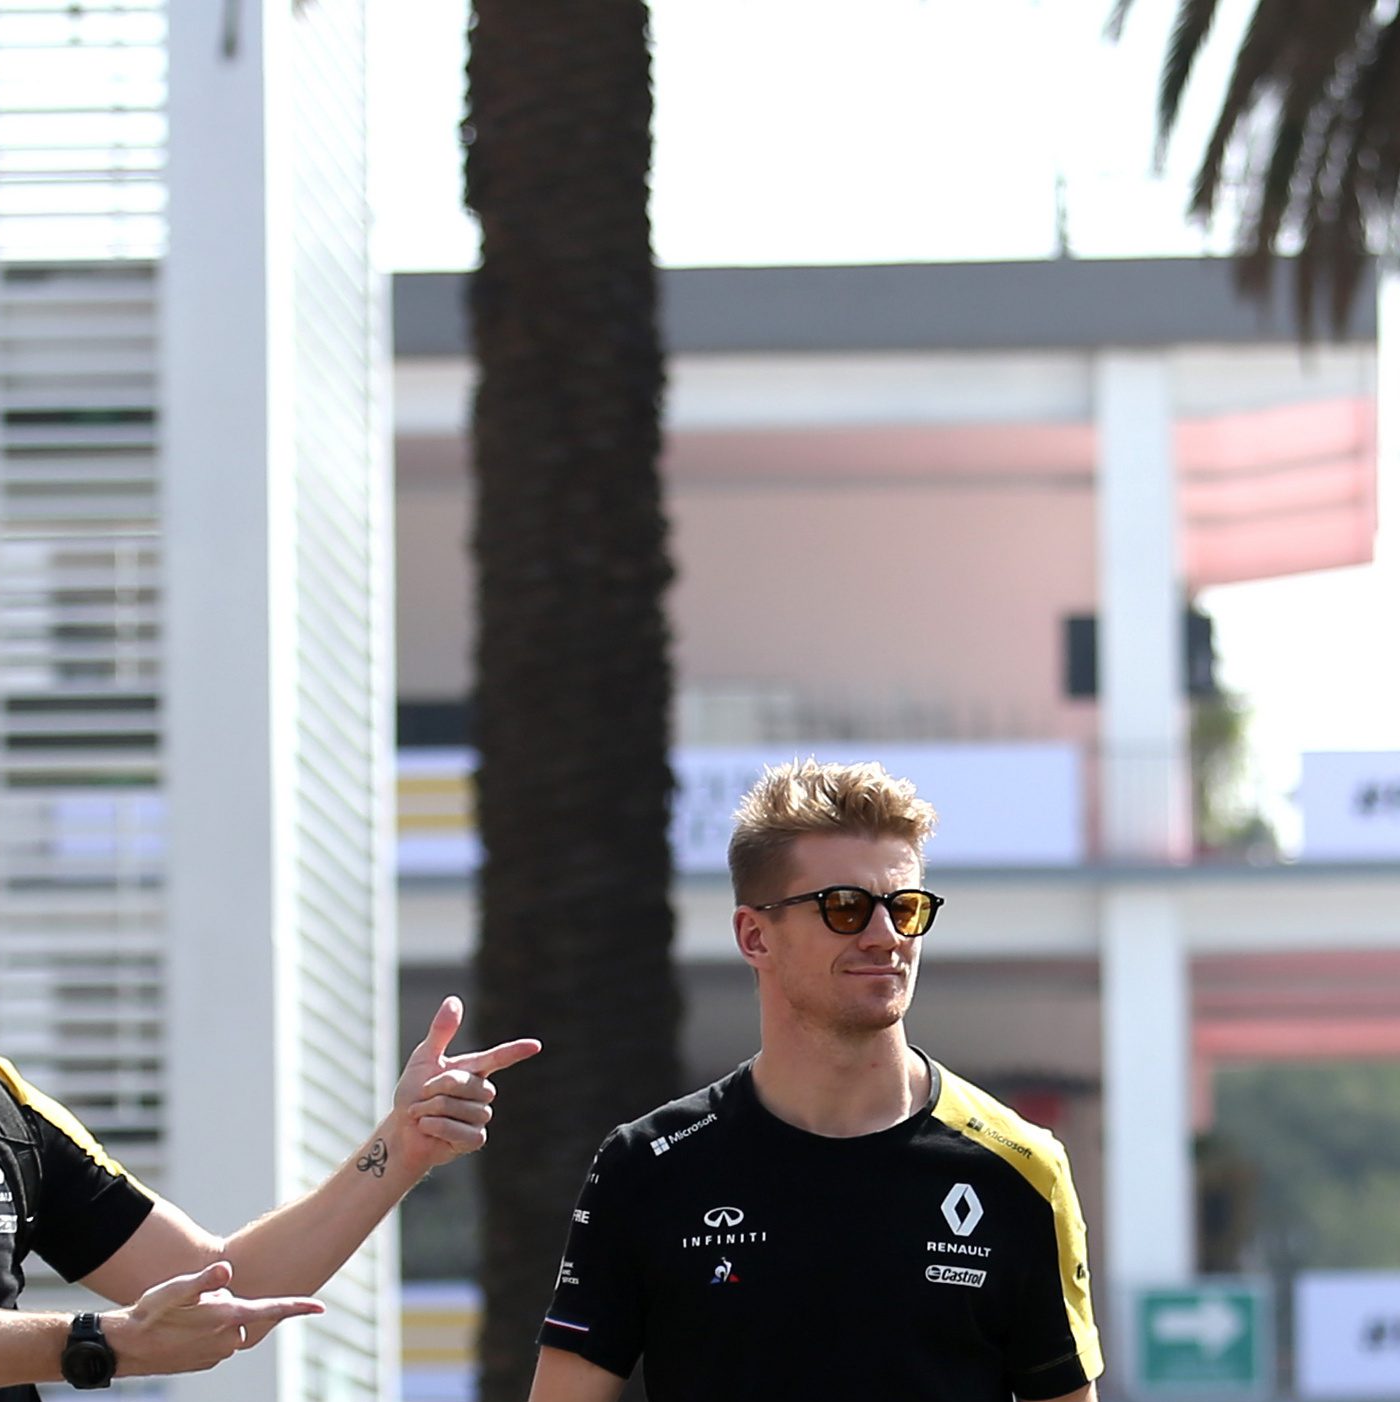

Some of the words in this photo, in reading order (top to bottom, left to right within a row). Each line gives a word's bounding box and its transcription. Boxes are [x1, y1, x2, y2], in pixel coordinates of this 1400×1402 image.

[668, 1112, 718, 1145] Microsoft
[984, 1126, 1033, 1160] Microsoft
[682, 1231, 767, 1249] INFINITI
[926, 1241, 991, 1257] RENAULT
[941, 1267, 983, 1285] Castrol
